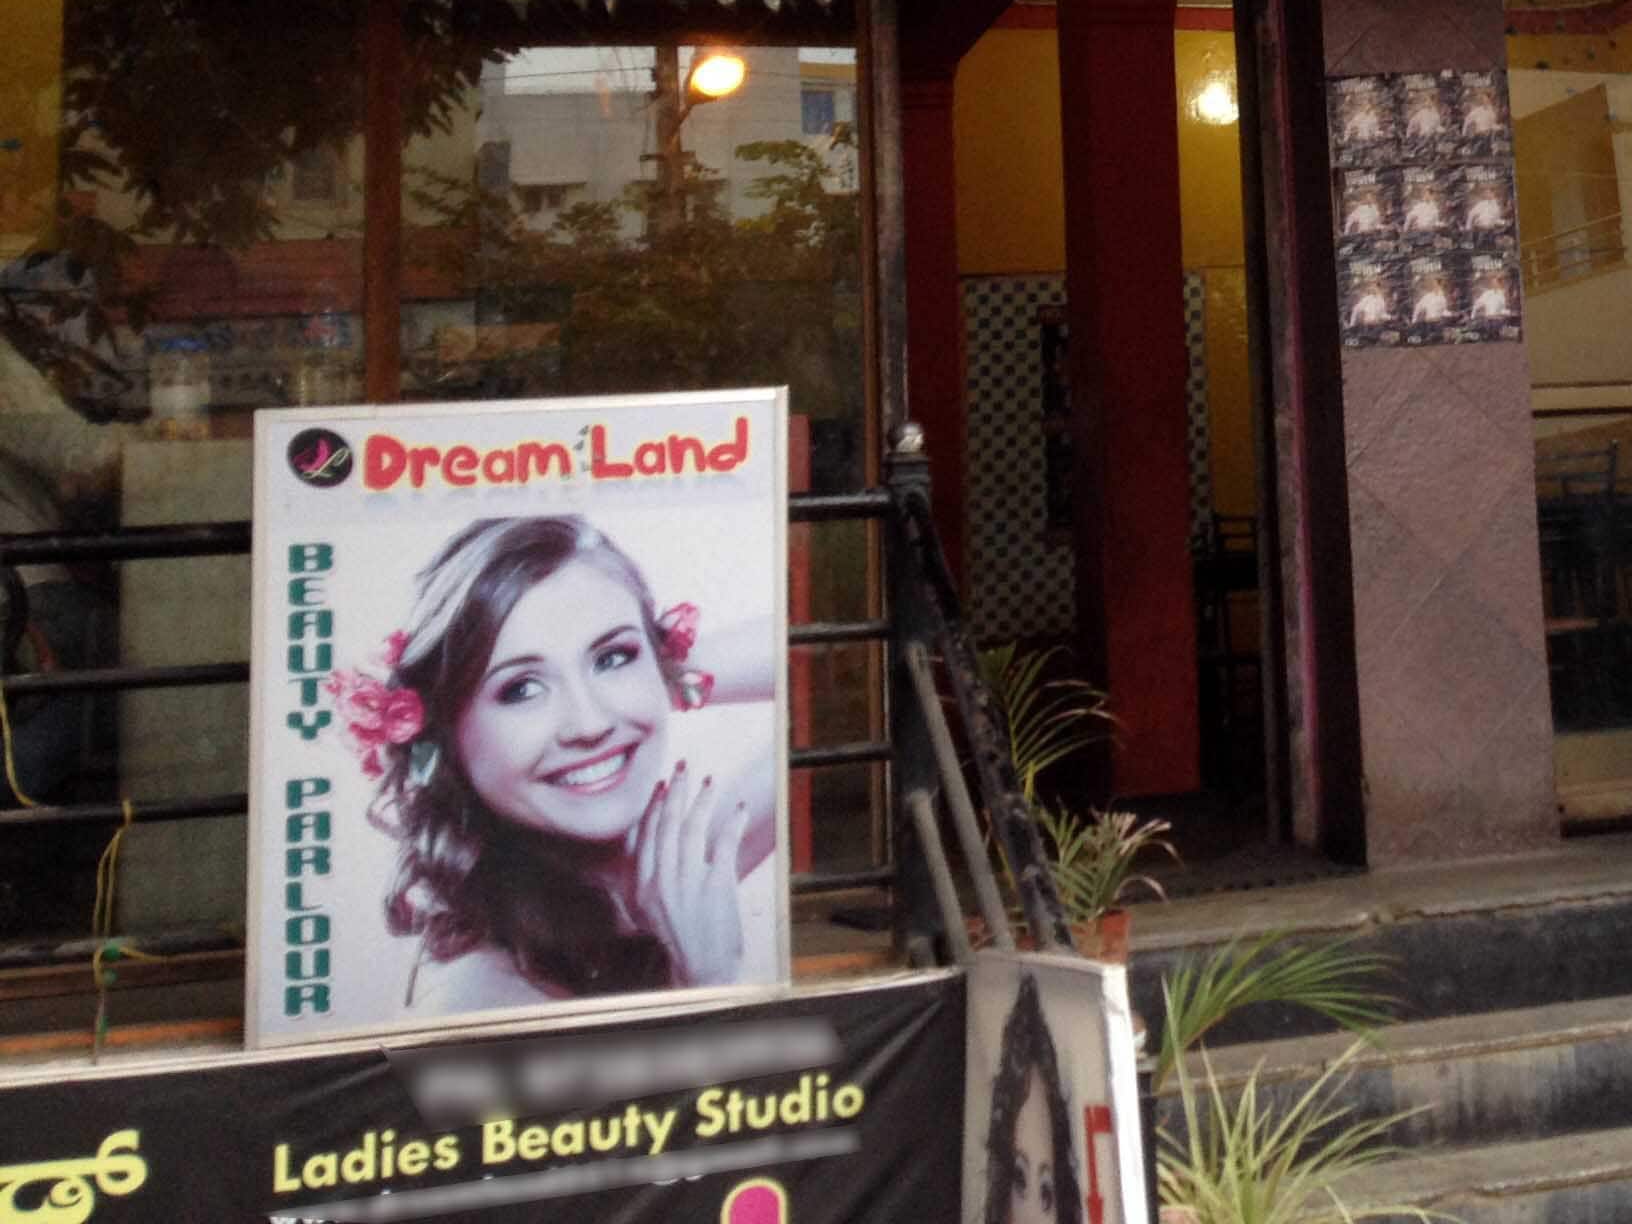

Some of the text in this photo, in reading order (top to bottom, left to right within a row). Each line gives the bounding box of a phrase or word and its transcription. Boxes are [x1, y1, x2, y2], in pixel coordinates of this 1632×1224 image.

[363, 416, 748, 490] Dream Land
[287, 542, 334, 741] BEAUTY
[284, 777, 332, 1016] PARLOUR
[273, 1129, 460, 1193] Ladies
[482, 1105, 676, 1158] Beauty
[695, 1075, 866, 1137] Studio
